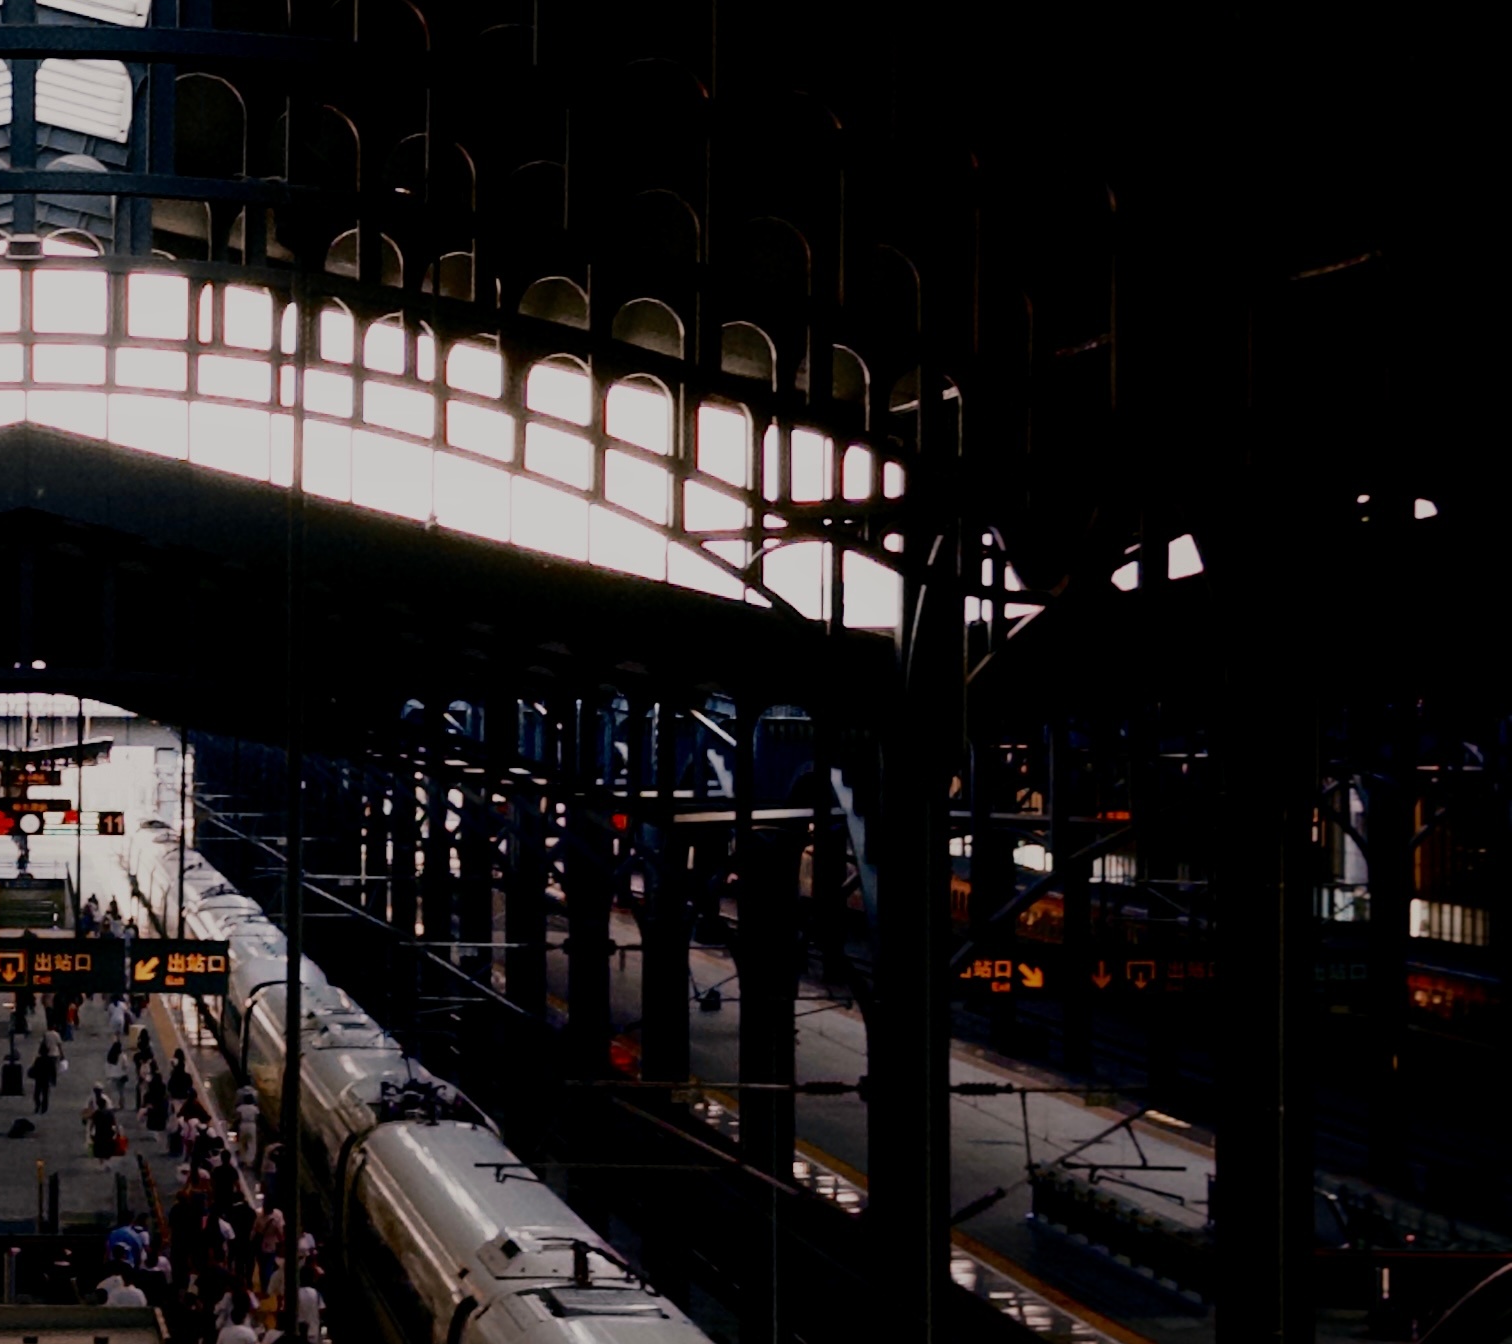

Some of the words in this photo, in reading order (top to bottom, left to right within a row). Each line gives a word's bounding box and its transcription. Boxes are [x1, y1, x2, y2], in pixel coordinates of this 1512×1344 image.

[104, 815, 123, 832] 11
[34, 952, 92, 972] 出站口
[166, 952, 226, 973] 出站口
